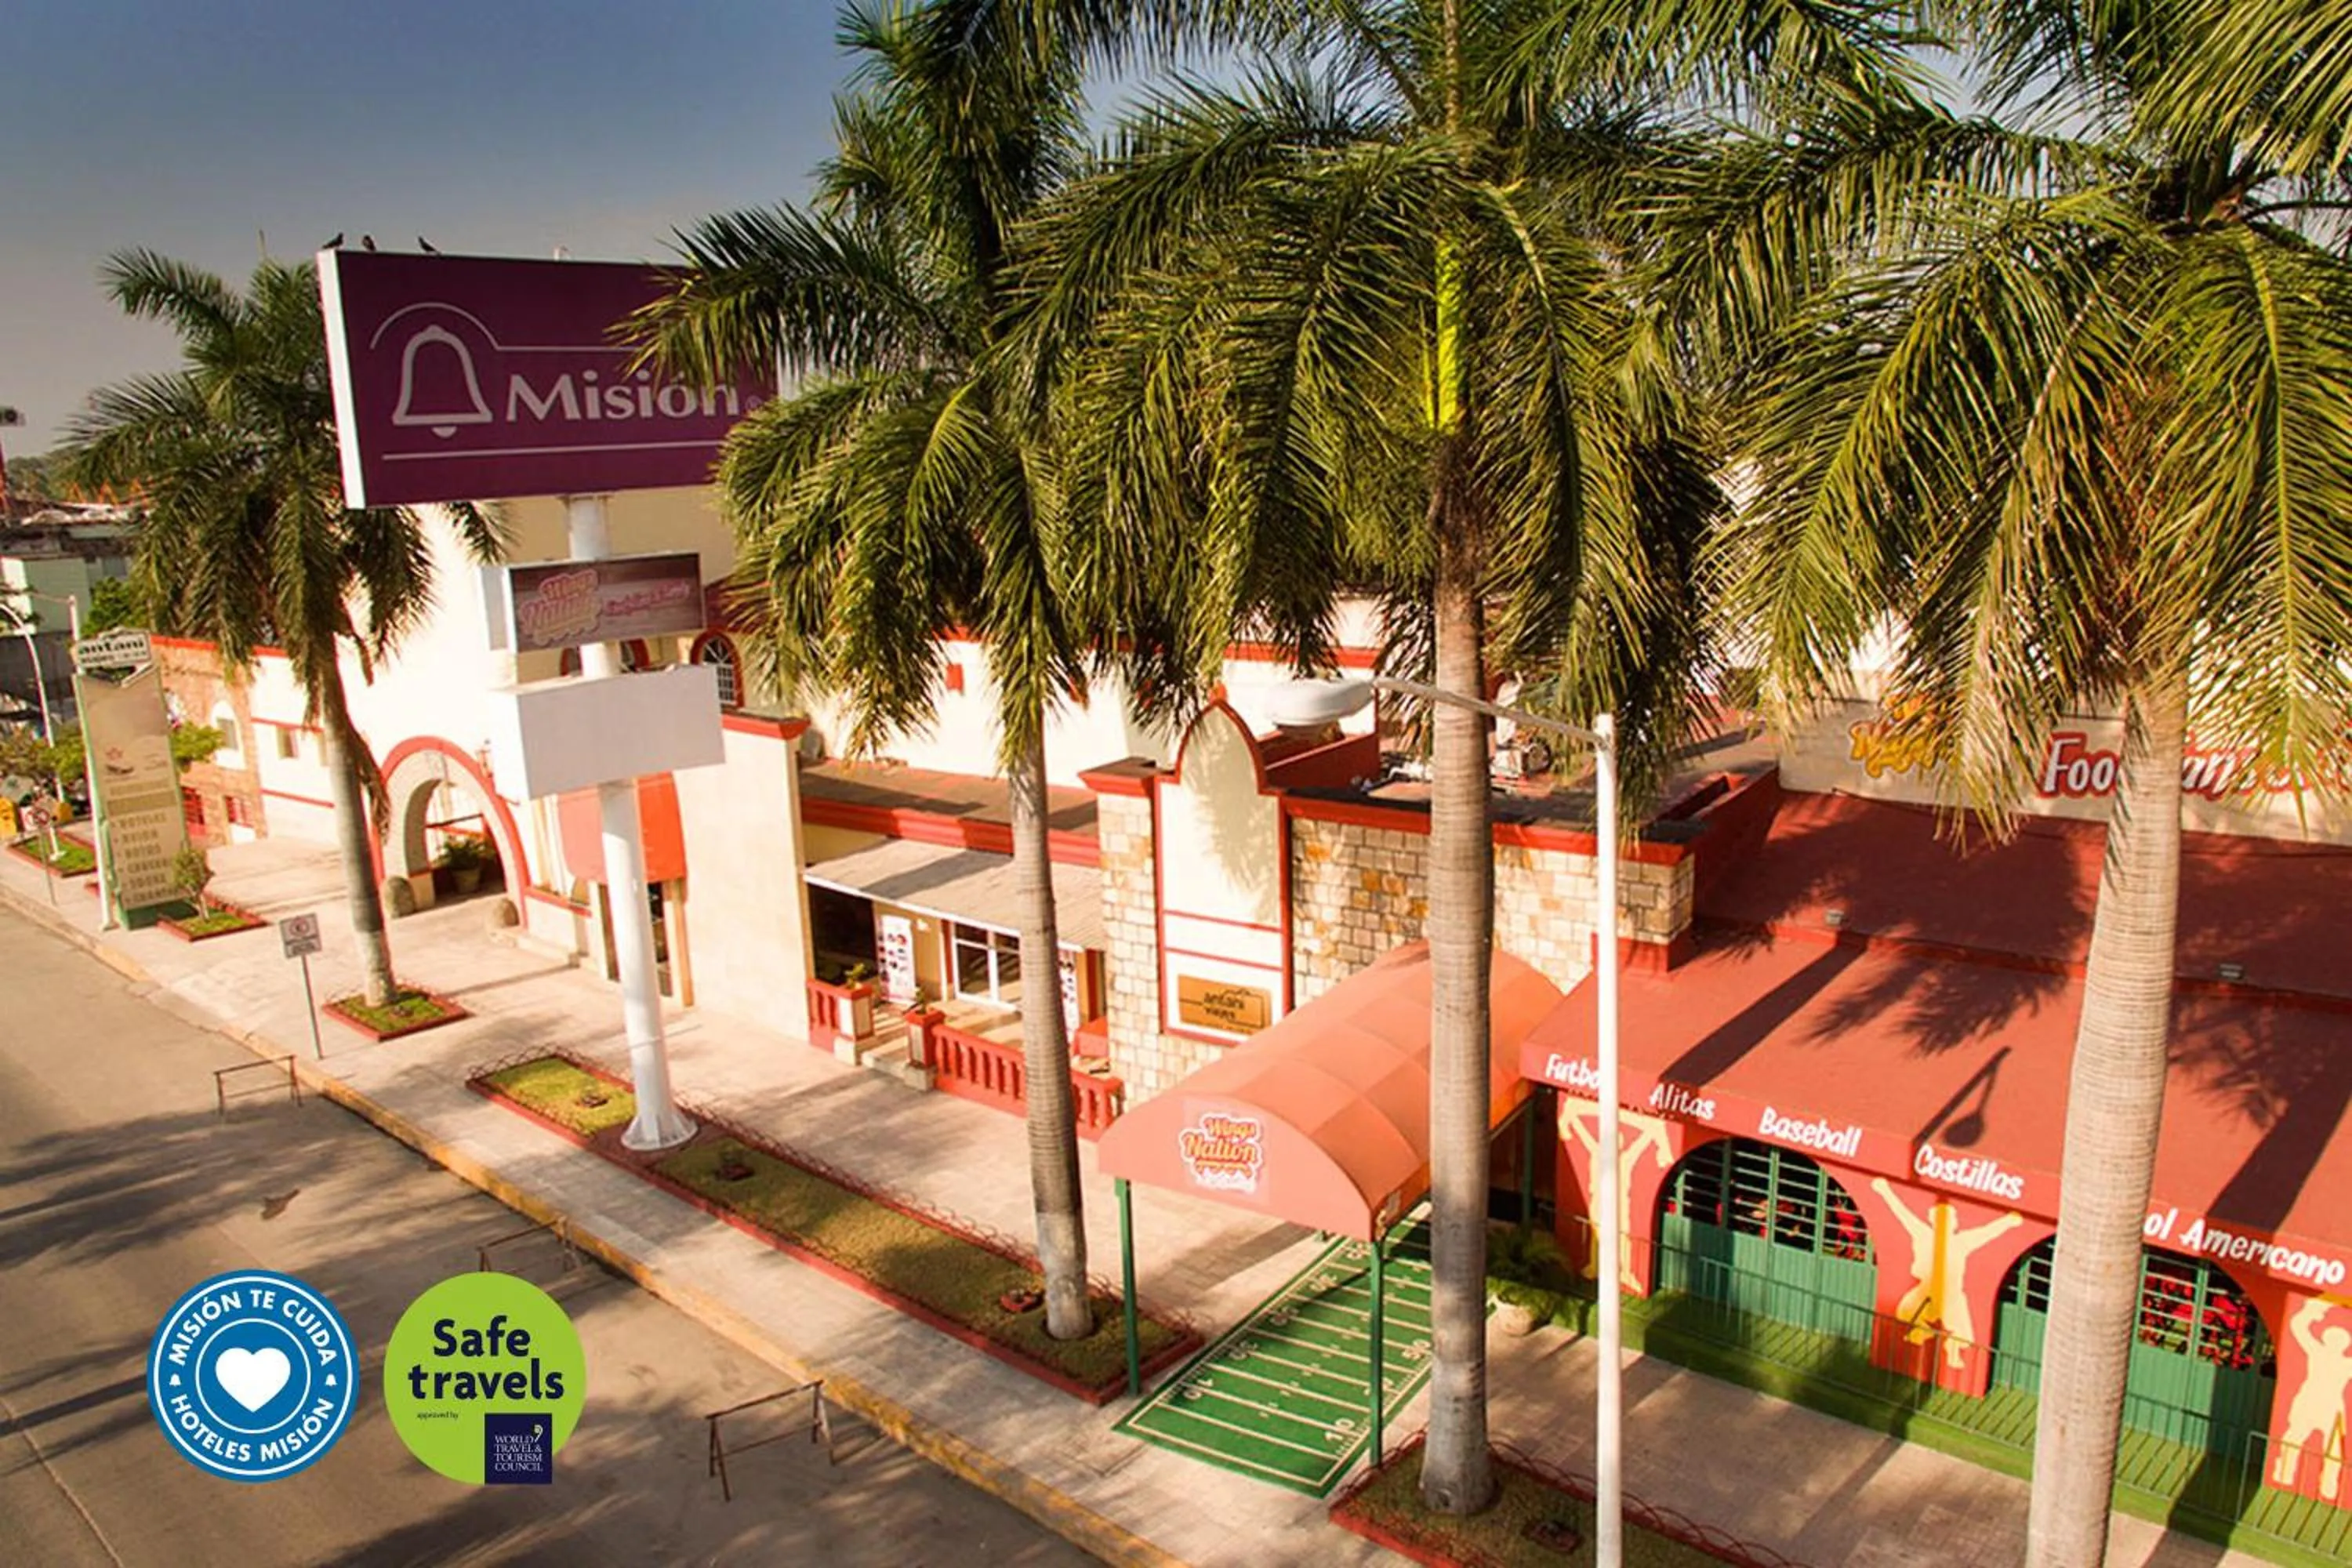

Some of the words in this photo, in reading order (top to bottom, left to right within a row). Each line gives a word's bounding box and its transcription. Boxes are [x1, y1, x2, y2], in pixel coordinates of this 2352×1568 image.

[506, 370, 740, 422] Misión
[1545, 1053, 1601, 1091] Futbo
[1650, 1083, 1715, 1121] Alitas
[1759, 1105, 1862, 1158] Baseball
[1914, 1144, 2024, 1200] Costillas
[2180, 1217, 2346, 1286] Americano
